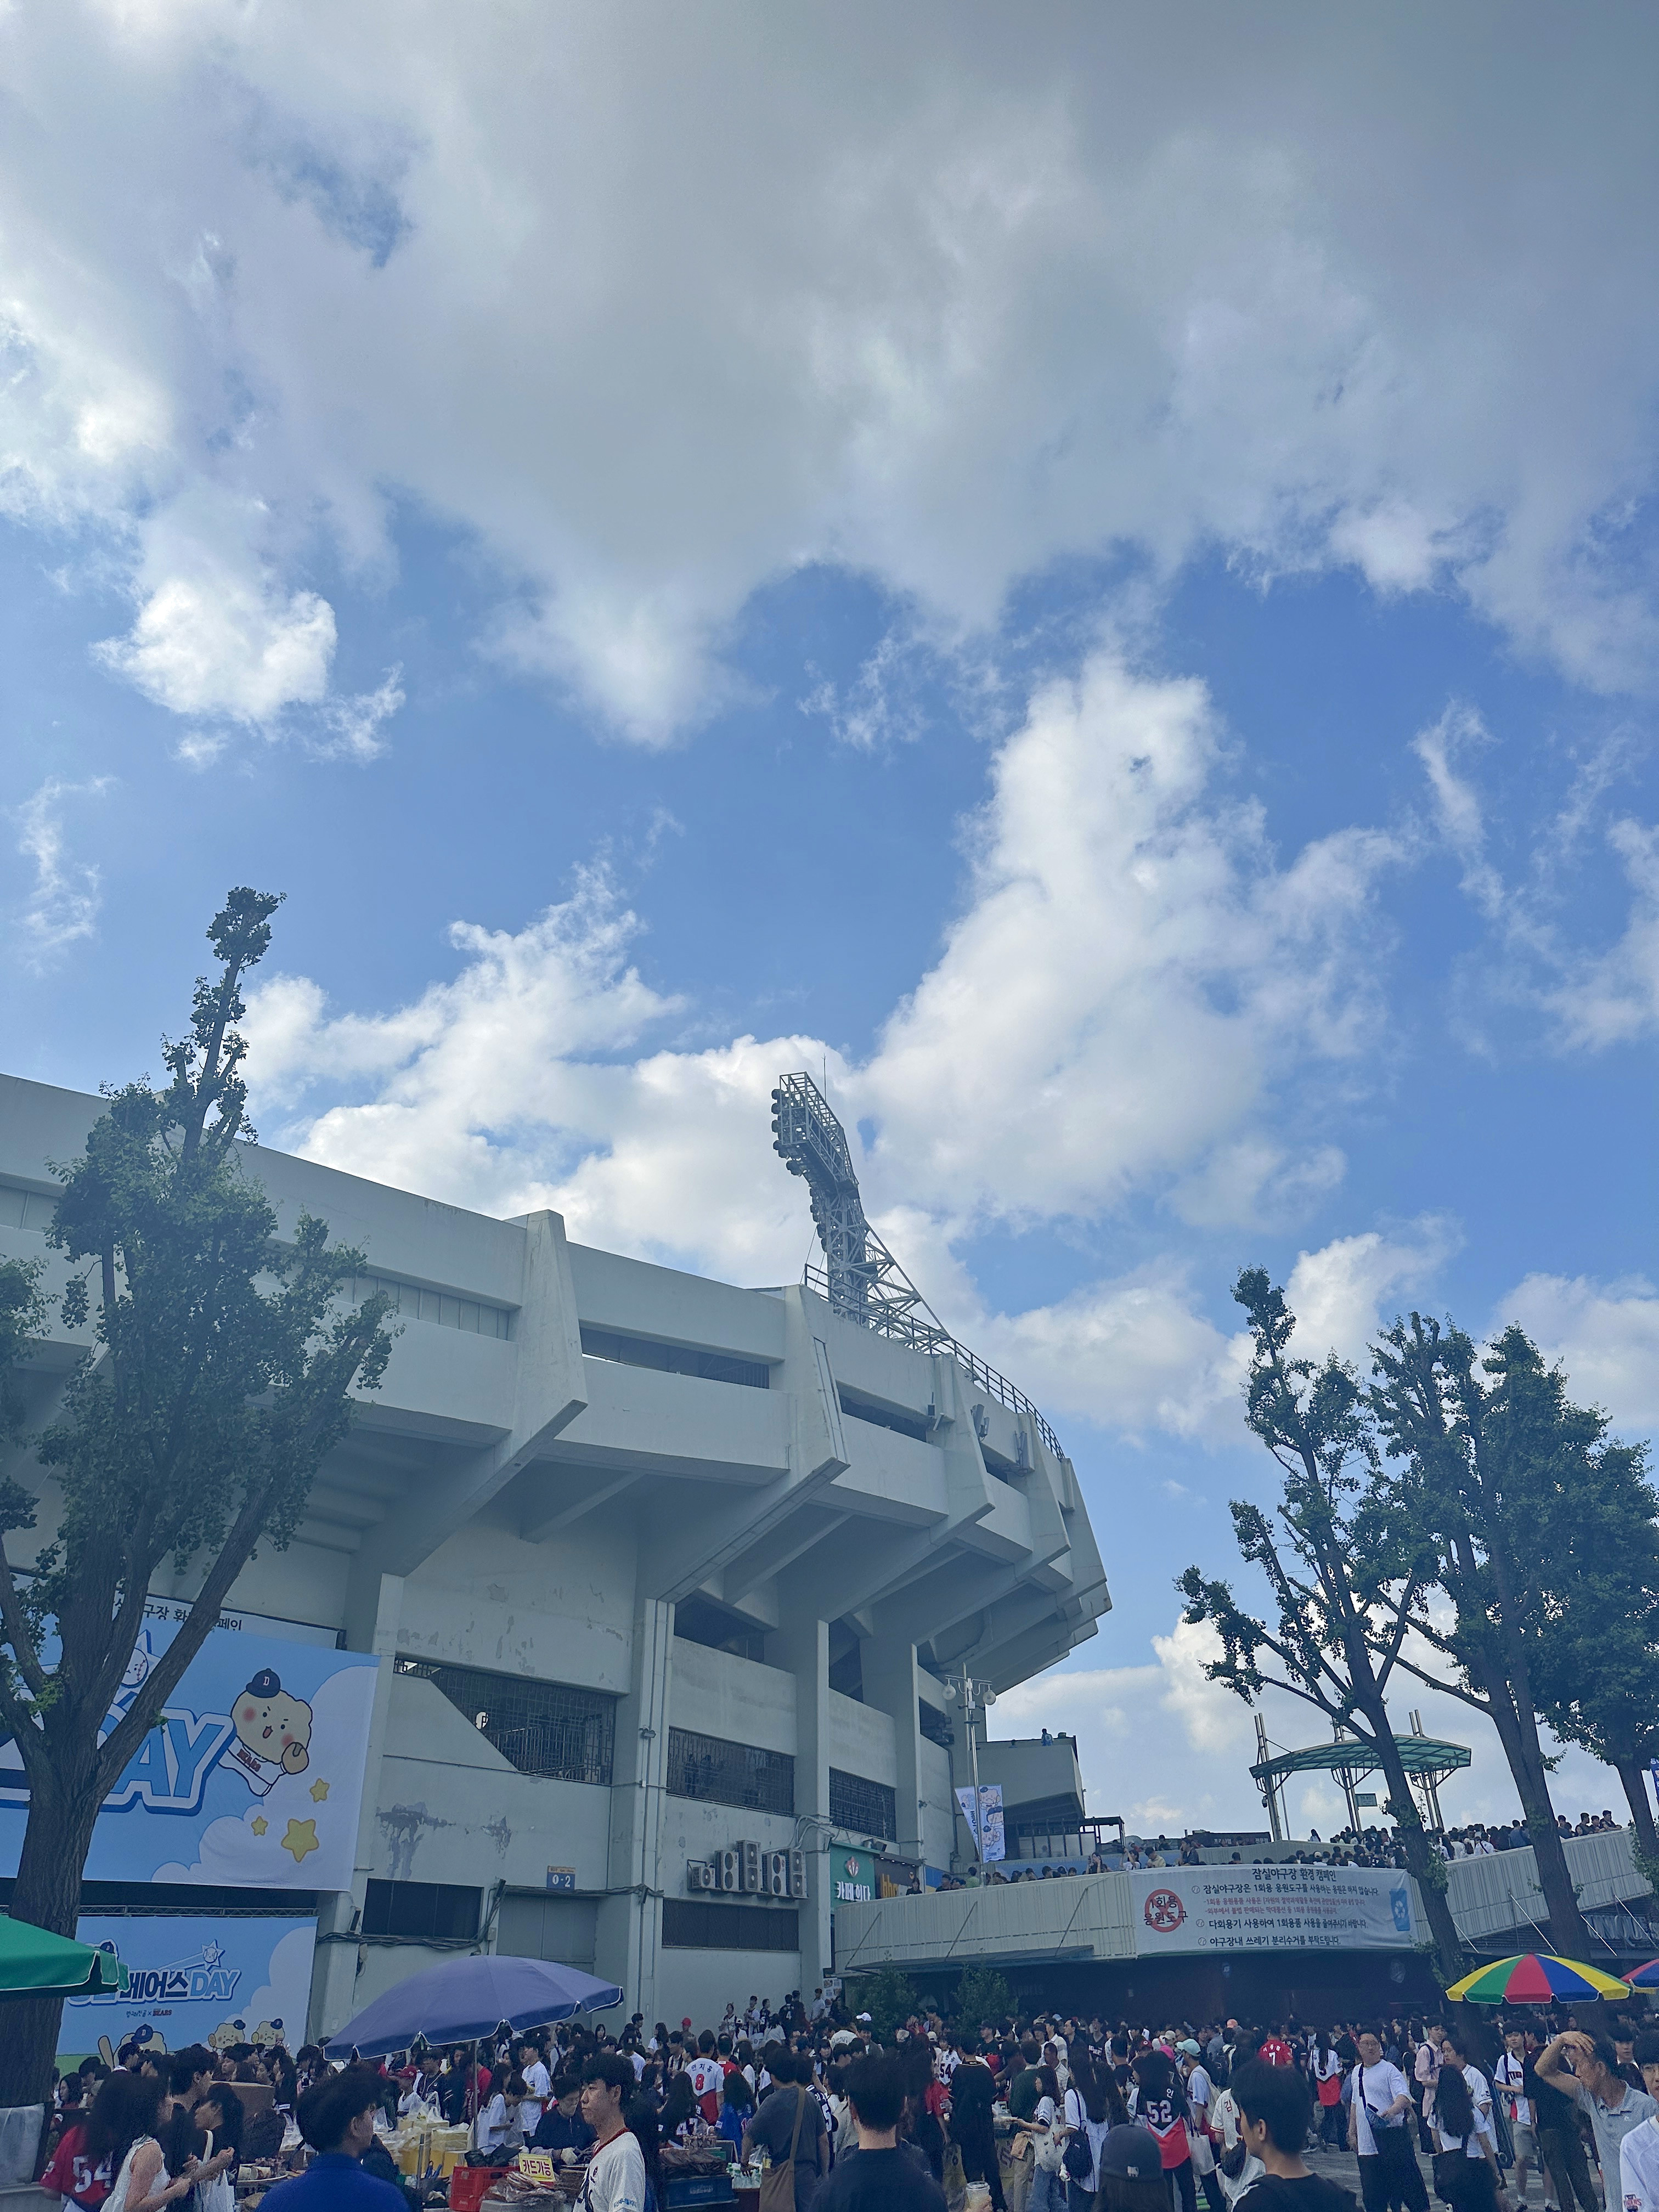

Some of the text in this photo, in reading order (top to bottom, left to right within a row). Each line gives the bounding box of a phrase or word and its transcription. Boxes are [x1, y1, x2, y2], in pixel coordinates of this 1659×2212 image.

[263, 1677, 269, 1686] D
[1252, 1868, 1336, 1882] 잠실야구장 환경 캠페인
[837, 1881, 854, 1901] 카페
[1203, 1883, 1380, 1896] 잠실야구장은 1회용 응원도구를 사용하는 응원은 하지 않습니다.
[1150, 1895, 1177, 1908] 1회용
[1144, 1911, 1188, 1925] 응원도구
[1209, 1918, 1368, 1929] 다회용기 사용하여 1회용품 사용을 줄여주시기 바랍니다.
[1210, 1936, 1341, 1946] 야구장내 쓰레기 분리수거를 부탁드립니다.
[1268, 2052, 1276, 2066] 7
[940, 2063, 952, 2078] 54
[695, 2073, 704, 2091] 8
[1146, 2100, 1172, 2123] 52
[1224, 2099, 1232, 2113] 김
[73, 2152, 113, 2193] 54
[522, 2159, 551, 2176] 카드가능
